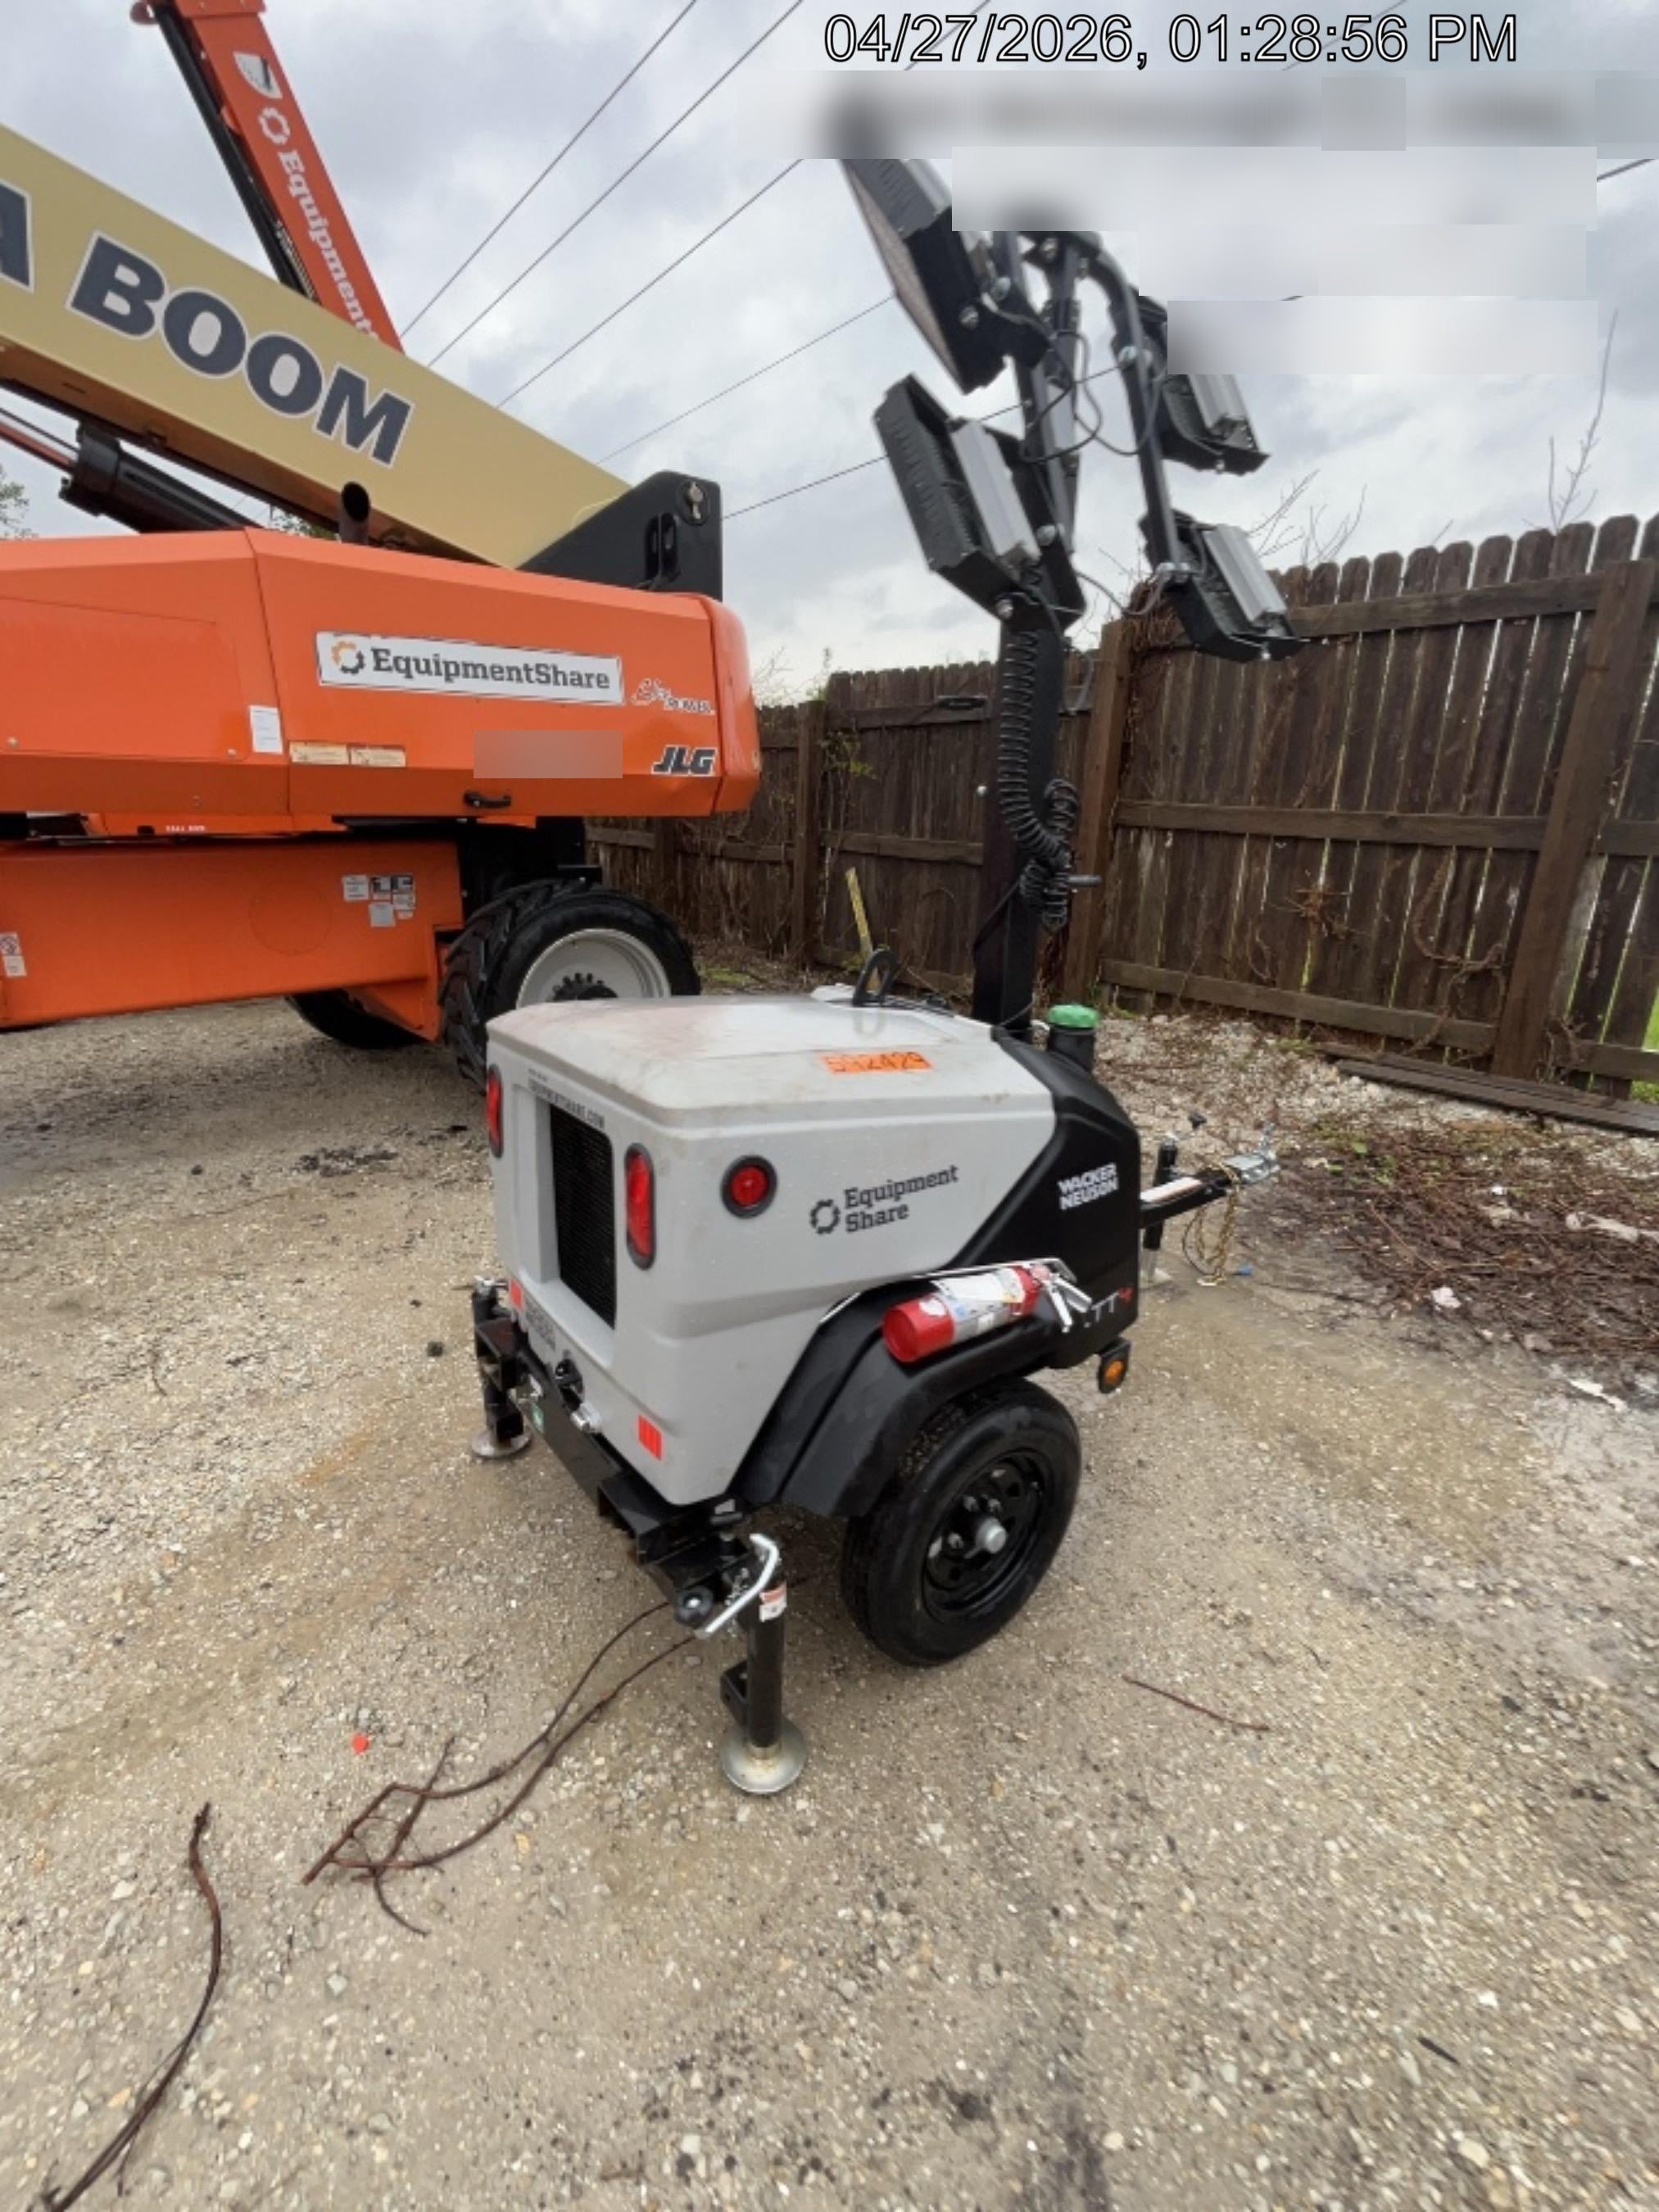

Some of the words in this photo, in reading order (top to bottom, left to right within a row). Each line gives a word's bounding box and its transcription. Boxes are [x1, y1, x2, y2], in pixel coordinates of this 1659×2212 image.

[278, 149, 380, 341] Equipment
[66, 230, 415, 468] BOOM
[370, 647, 610, 690] EquipmentShare
[651, 744, 718, 776] JLG
[844, 1164, 959, 1209] Equipment
[1057, 1162, 1117, 1194] WACKER
[1059, 1176, 1120, 1210] NEUSON
[845, 1203, 910, 1234] Share
[1083, 1287, 1133, 1329] TT4
